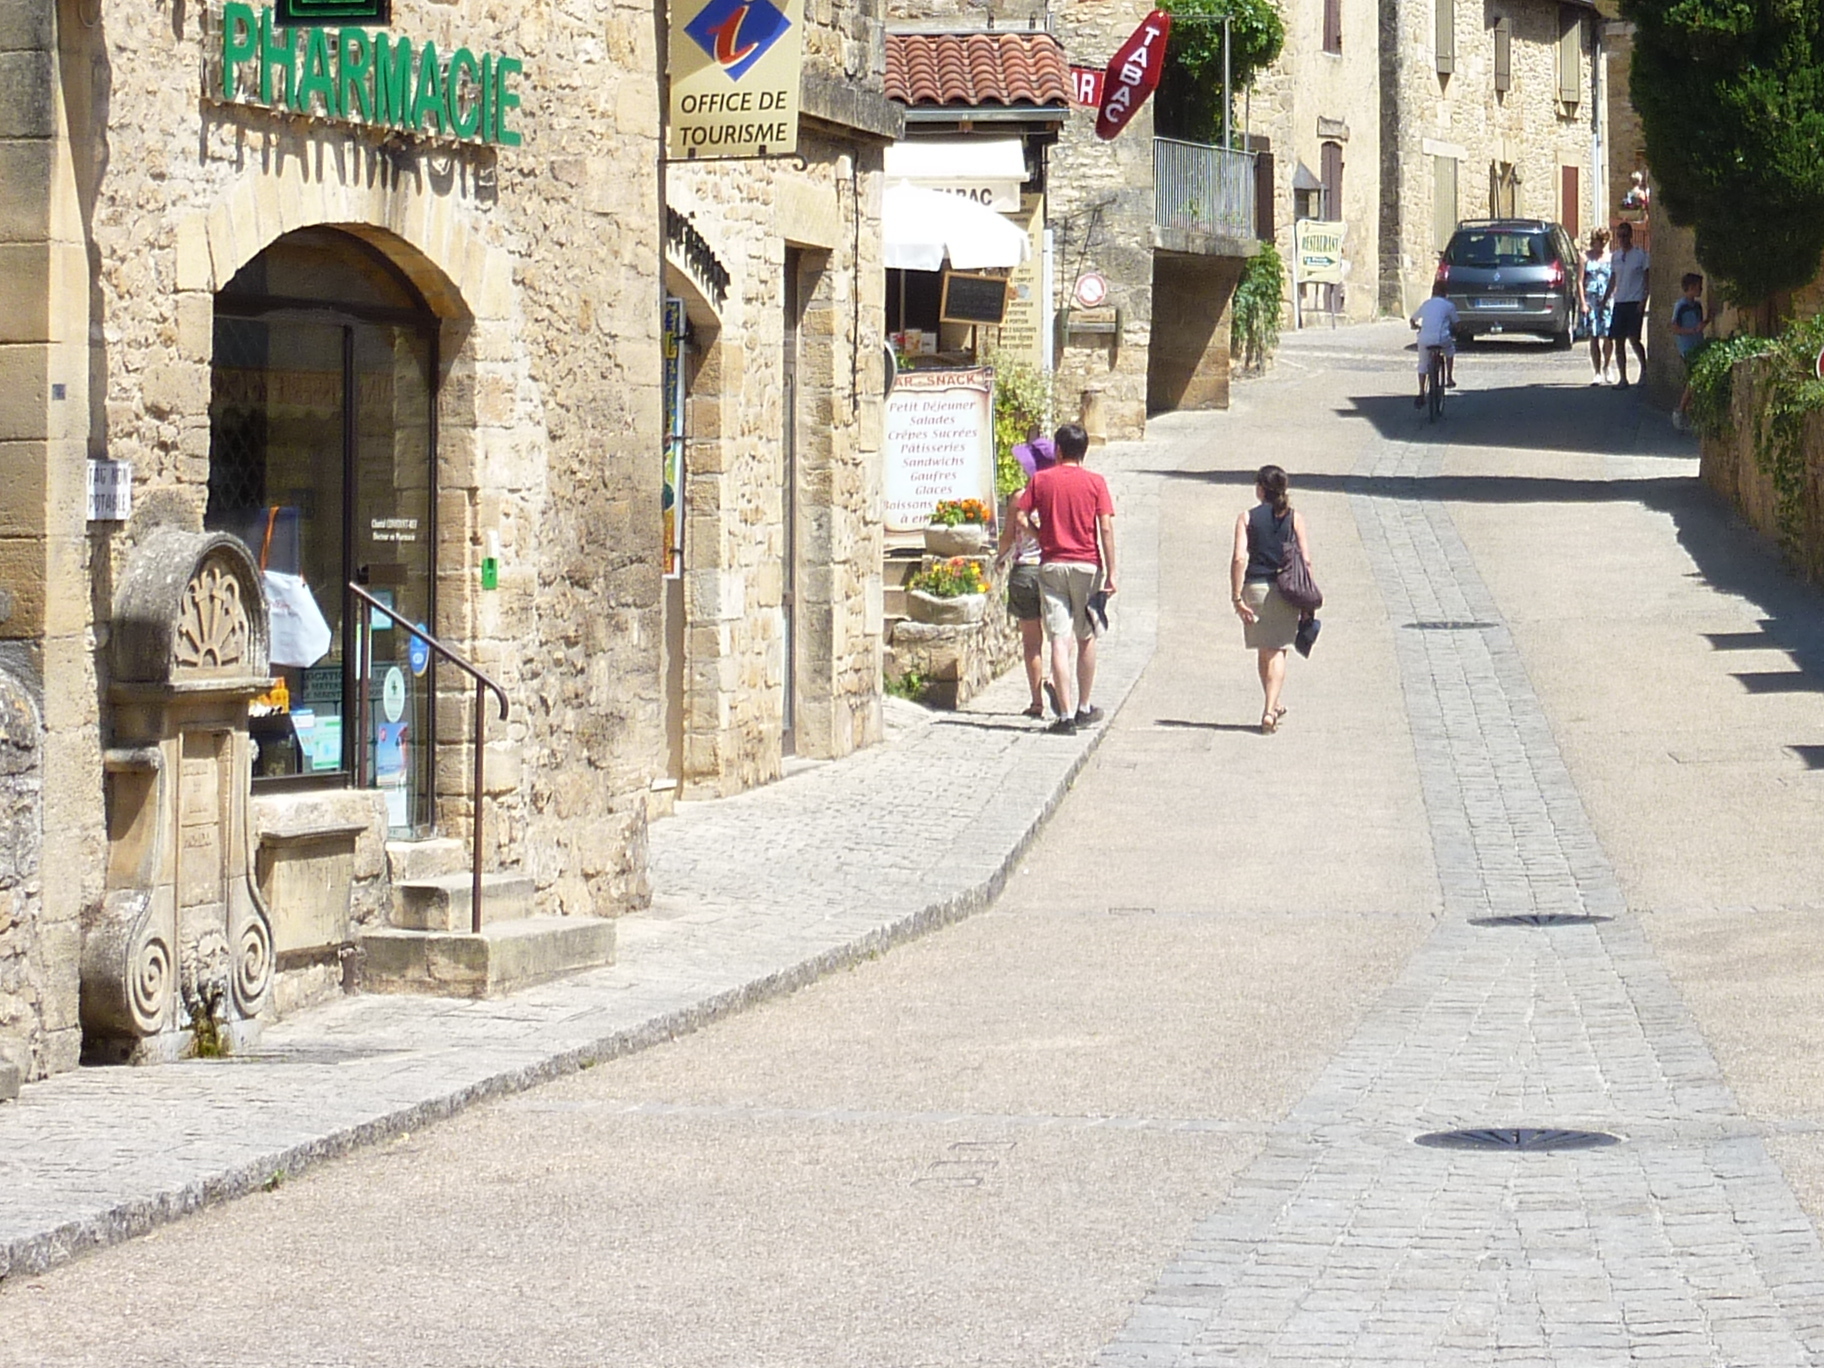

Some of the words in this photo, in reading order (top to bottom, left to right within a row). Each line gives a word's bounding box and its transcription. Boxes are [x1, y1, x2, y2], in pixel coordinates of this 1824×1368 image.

[223, 2, 522, 146] PHARMACIE
[1105, 26, 1160, 123] TABAC
[1071, 71, 1095, 103] AR
[681, 93, 752, 113] OFFICE
[758, 91, 788, 111] DE
[680, 123, 788, 146] TOURISME
[1301, 235, 1339, 252] RESTAURANT
[895, 376, 913, 387] AR
[926, 374, 977, 386] SNACK
[889, 401, 918, 413] Petit
[922, 400, 977, 413] Déjeuner
[909, 415, 956, 426] Salades
[888, 429, 928, 443] Crêpes
[931, 427, 978, 439] Sucrées
[900, 442, 966, 454] Pâtisseries
[902, 455, 965, 468] Sandwichs
[910, 470, 957, 482] Gaufres
[915, 484, 953, 496] Glaces
